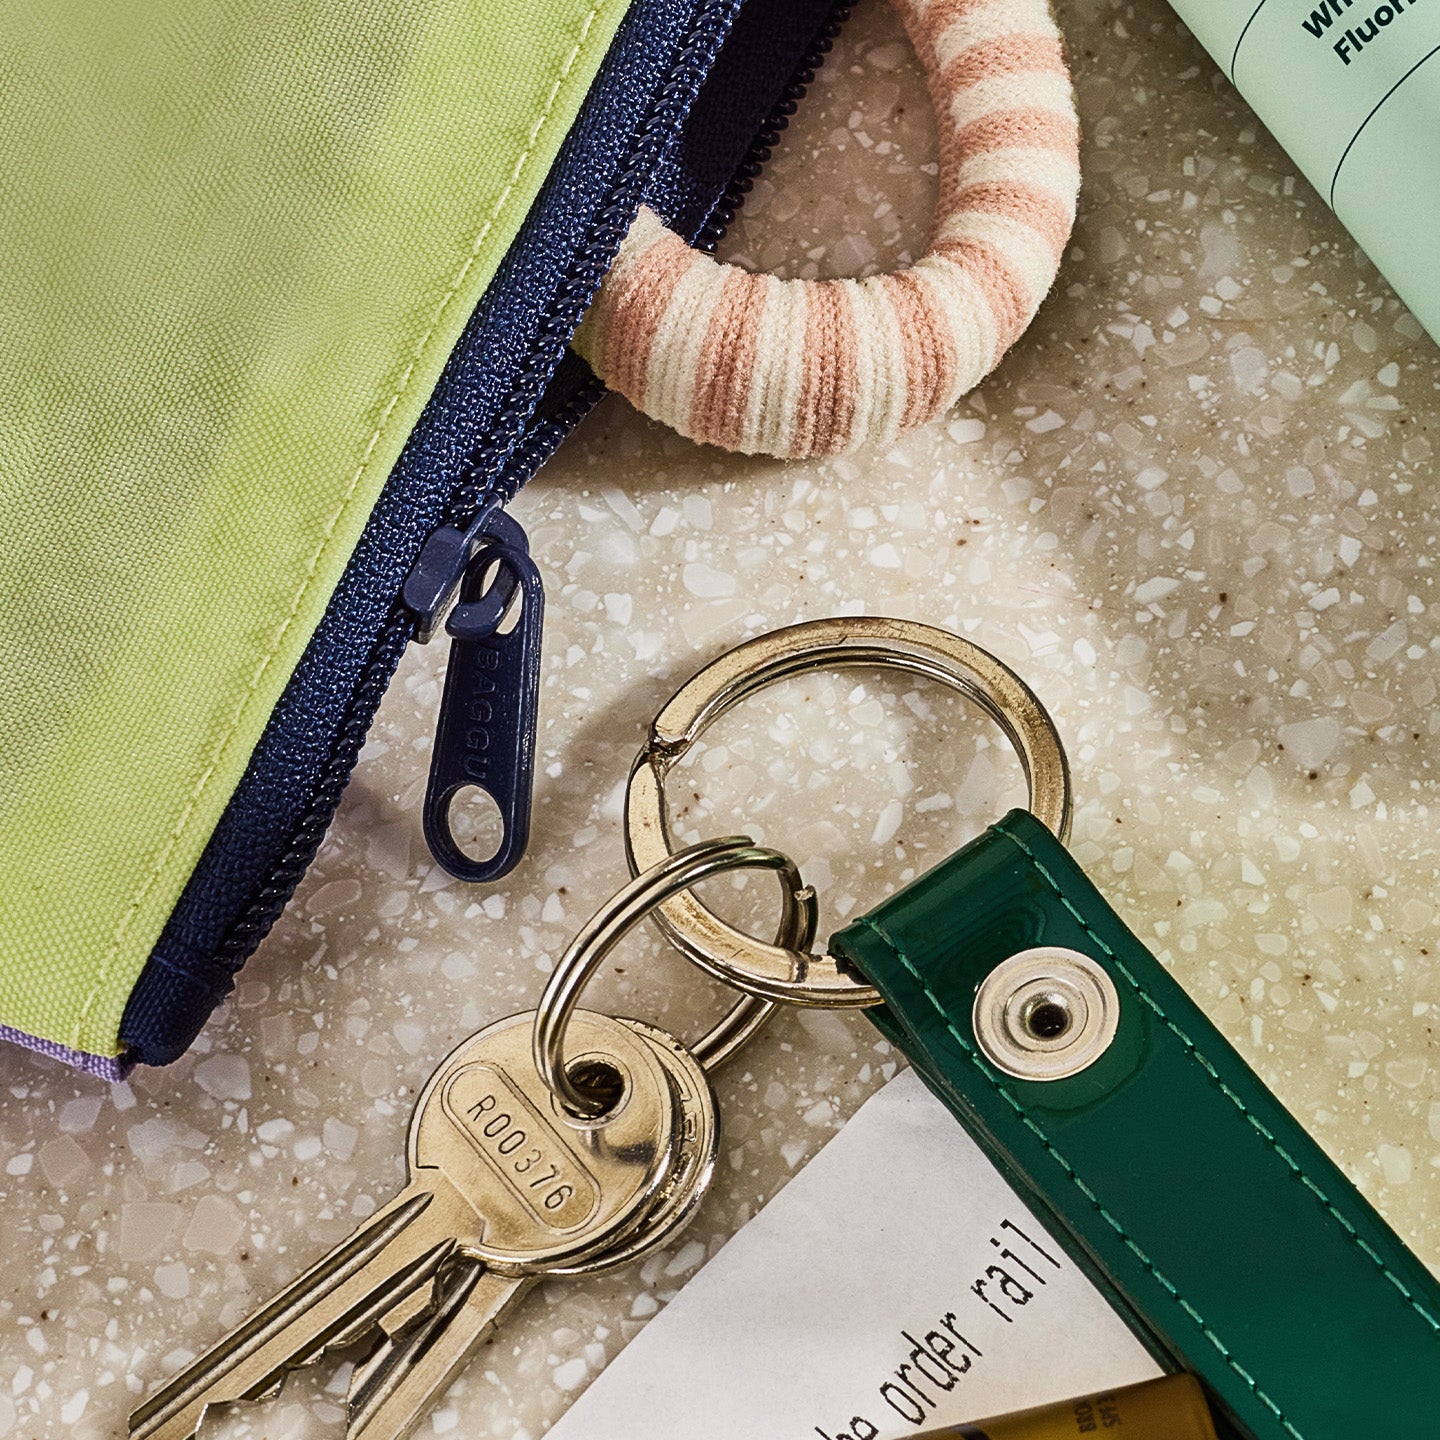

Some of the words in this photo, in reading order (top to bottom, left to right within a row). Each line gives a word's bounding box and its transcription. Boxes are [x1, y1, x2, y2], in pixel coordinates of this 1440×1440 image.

[463, 649, 500, 781] BAGGU
[879, 1312, 983, 1426] order
[970, 1218, 1061, 1323] rail
